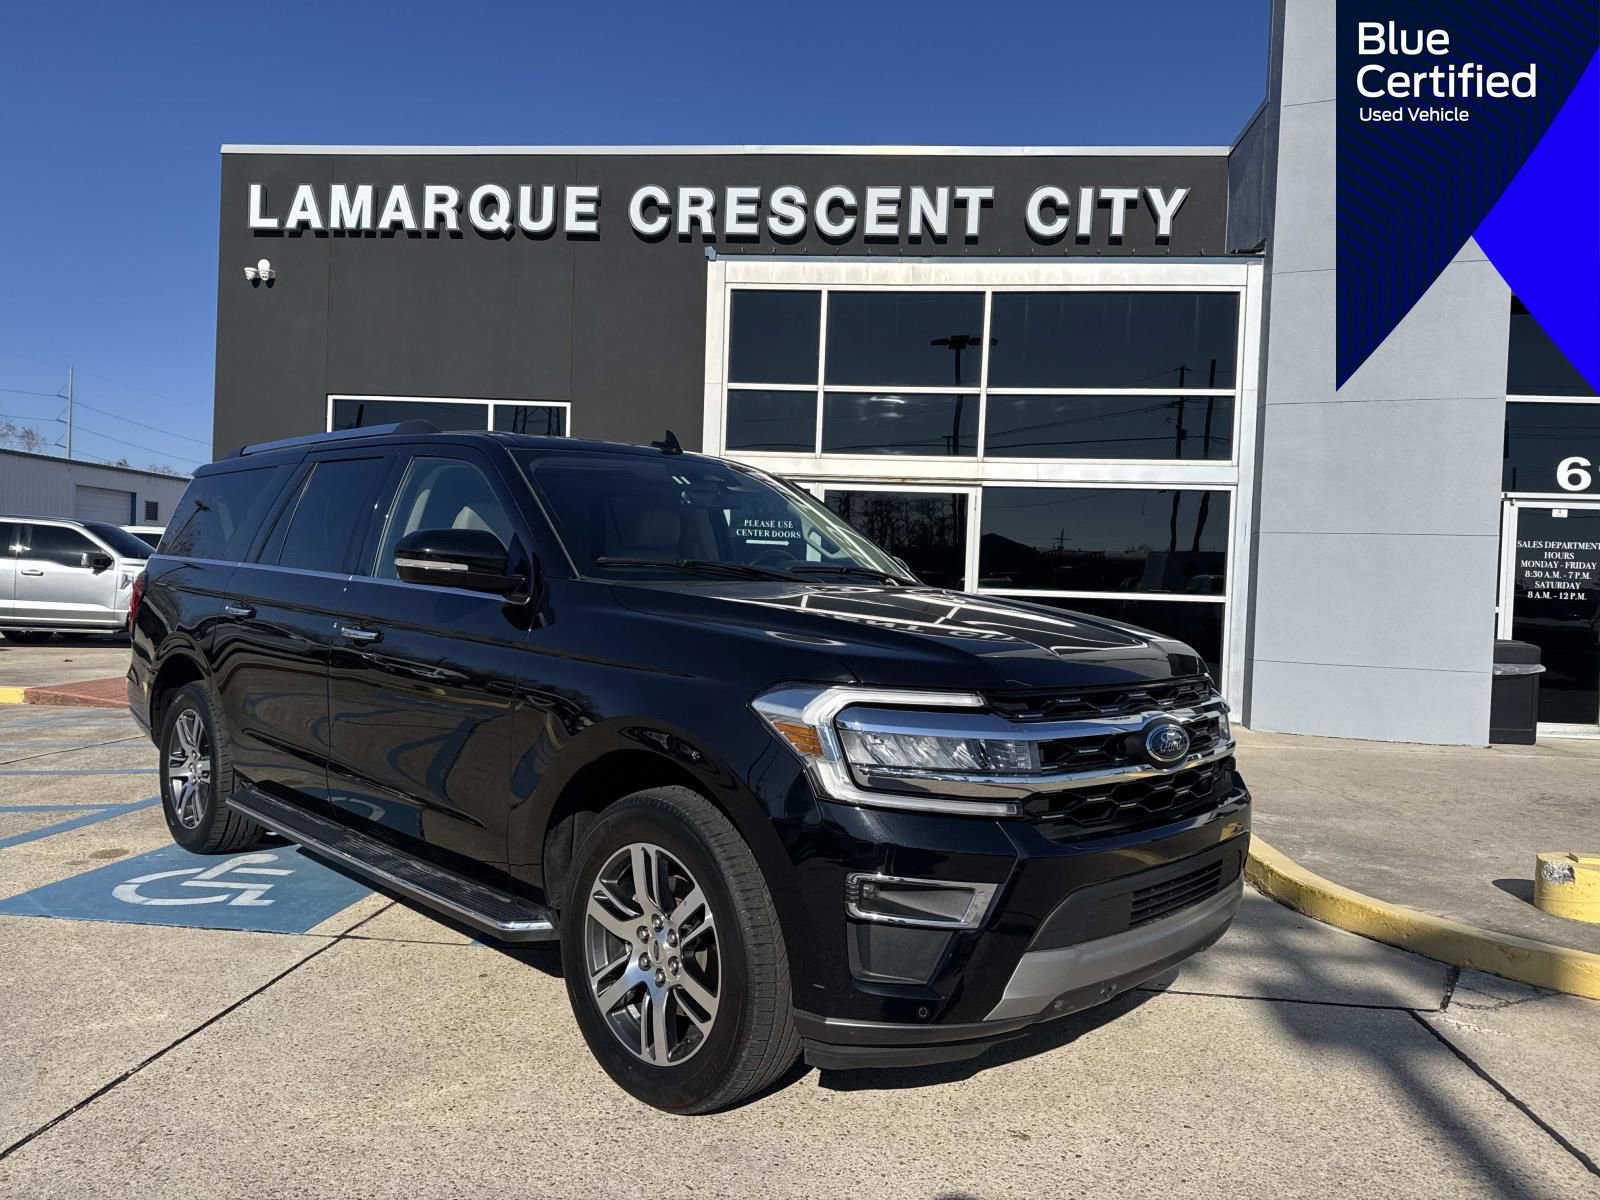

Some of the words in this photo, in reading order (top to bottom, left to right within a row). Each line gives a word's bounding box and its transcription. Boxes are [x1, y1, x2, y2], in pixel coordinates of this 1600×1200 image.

[248, 183, 600, 234] LAMARQUE
[628, 185, 995, 237] CRESCENT
[1025, 185, 1190, 238] CITY
[1556, 456, 1592, 491] 6
[744, 520, 775, 528] PLEASE
[777, 520, 794, 529] USE
[736, 529, 770, 537] CENTER
[771, 530, 801, 539] DOORS
[1517, 540, 1544, 549] SALES
[1544, 541, 1600, 550] DEPARTMENT
[1544, 551, 1575, 560] HOURS
[1520, 560, 1559, 569] MONDAY
[1564, 561, 1598, 570] FRIDAY
[1524, 570, 1543, 578] 8:30
[1568, 571, 1574, 579] 7
[1534, 580, 1581, 590] SATURDAY
[1527, 591, 1534, 599] 8
[1559, 592, 1569, 600] 12
[1159, 732, 1183, 752] Ford
